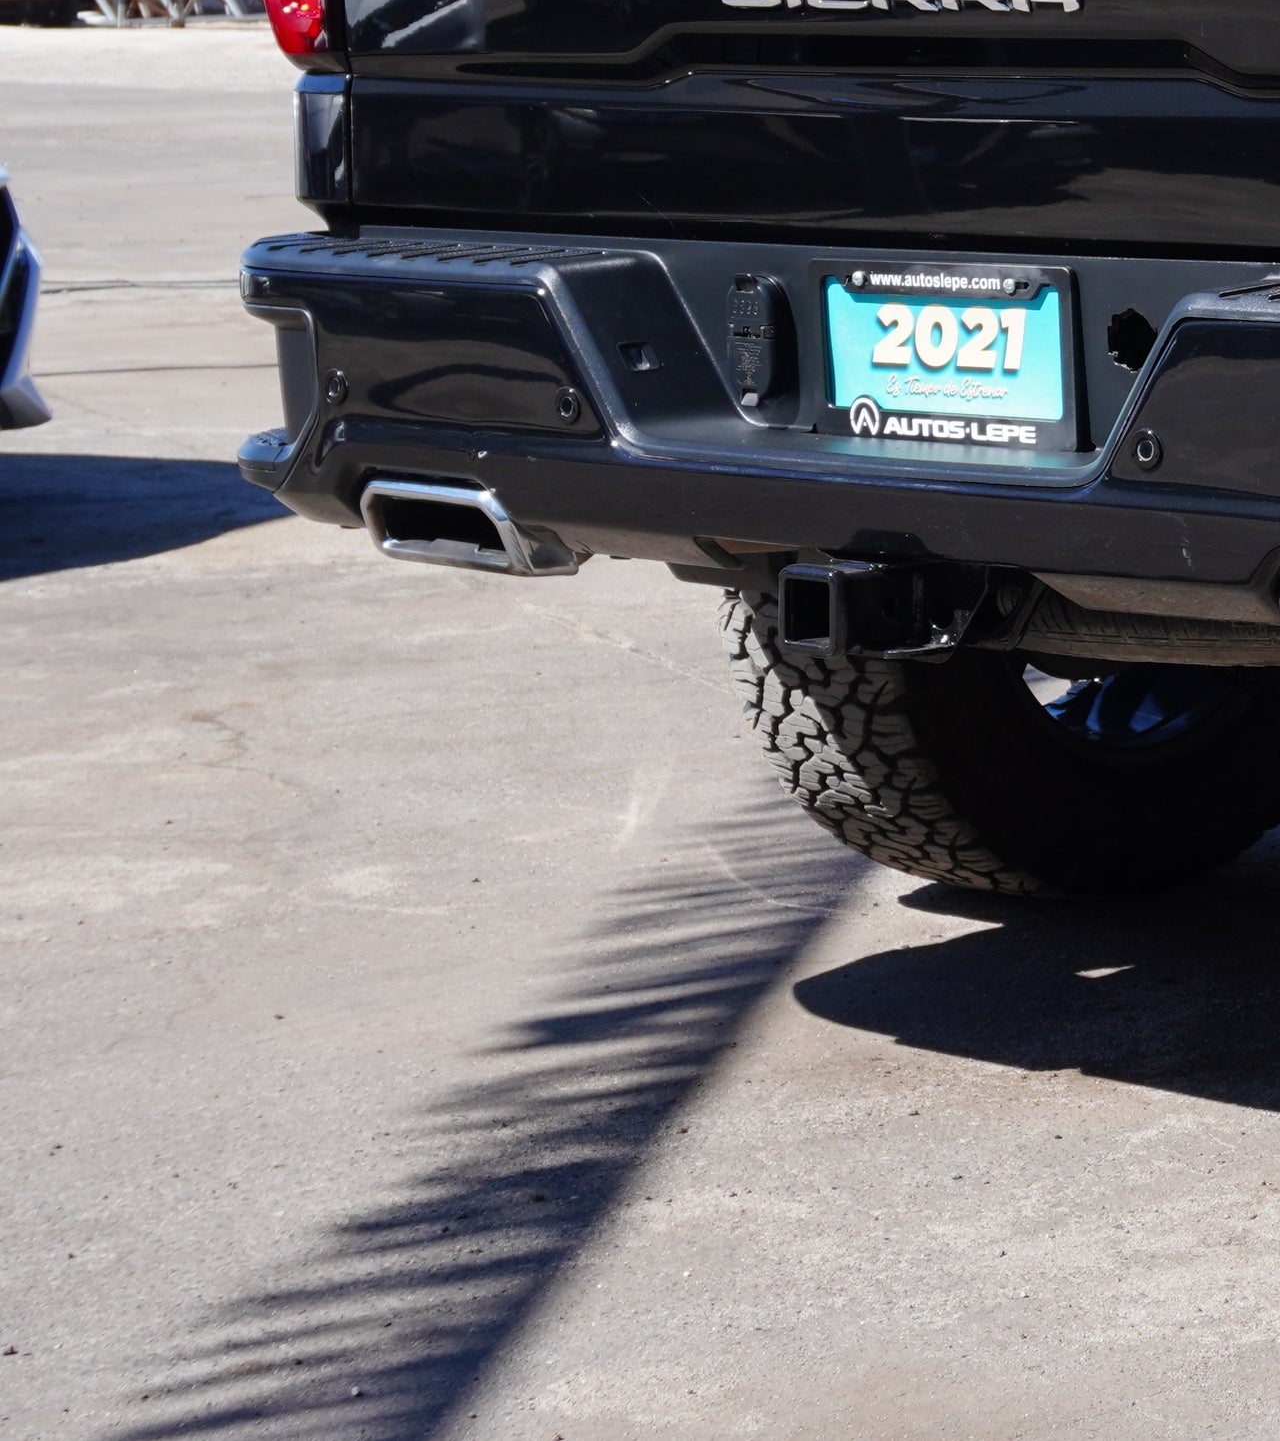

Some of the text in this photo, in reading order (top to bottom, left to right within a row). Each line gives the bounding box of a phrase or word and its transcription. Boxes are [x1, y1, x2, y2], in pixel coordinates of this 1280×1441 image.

[869, 271, 1001, 292] www.autoslepe.com
[872, 302, 1027, 371] 2021
[886, 373, 1009, 402] Es Tiempo de Estrenar
